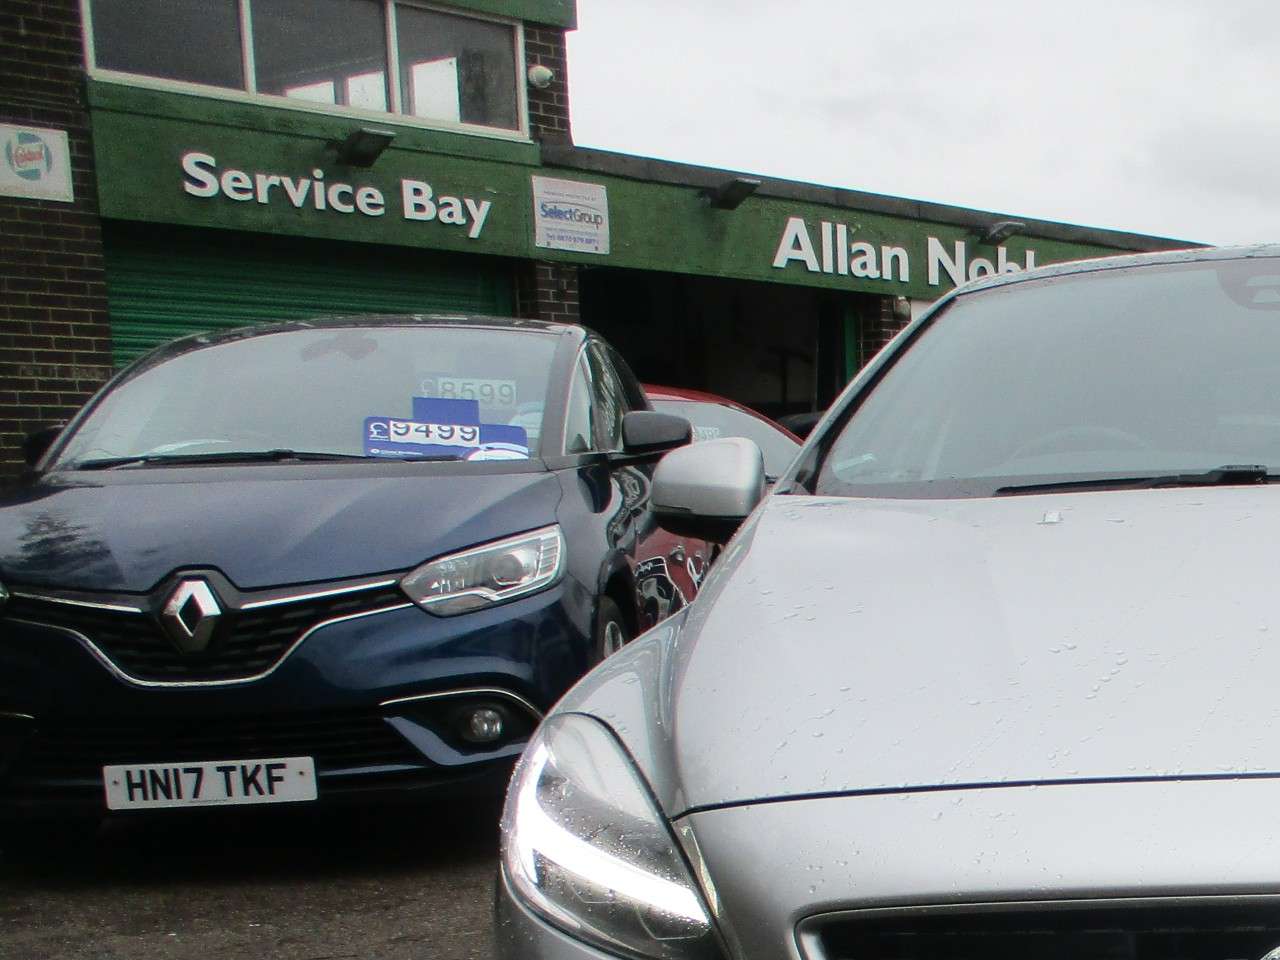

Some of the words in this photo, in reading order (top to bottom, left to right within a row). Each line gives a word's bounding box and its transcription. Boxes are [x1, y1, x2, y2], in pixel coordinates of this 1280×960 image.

[181, 151, 386, 217] Service
[401, 178, 491, 239] Bay
[772, 216, 910, 283] Allan
[125, 767, 204, 801] HN17
[215, 763, 287, 797] TKF
